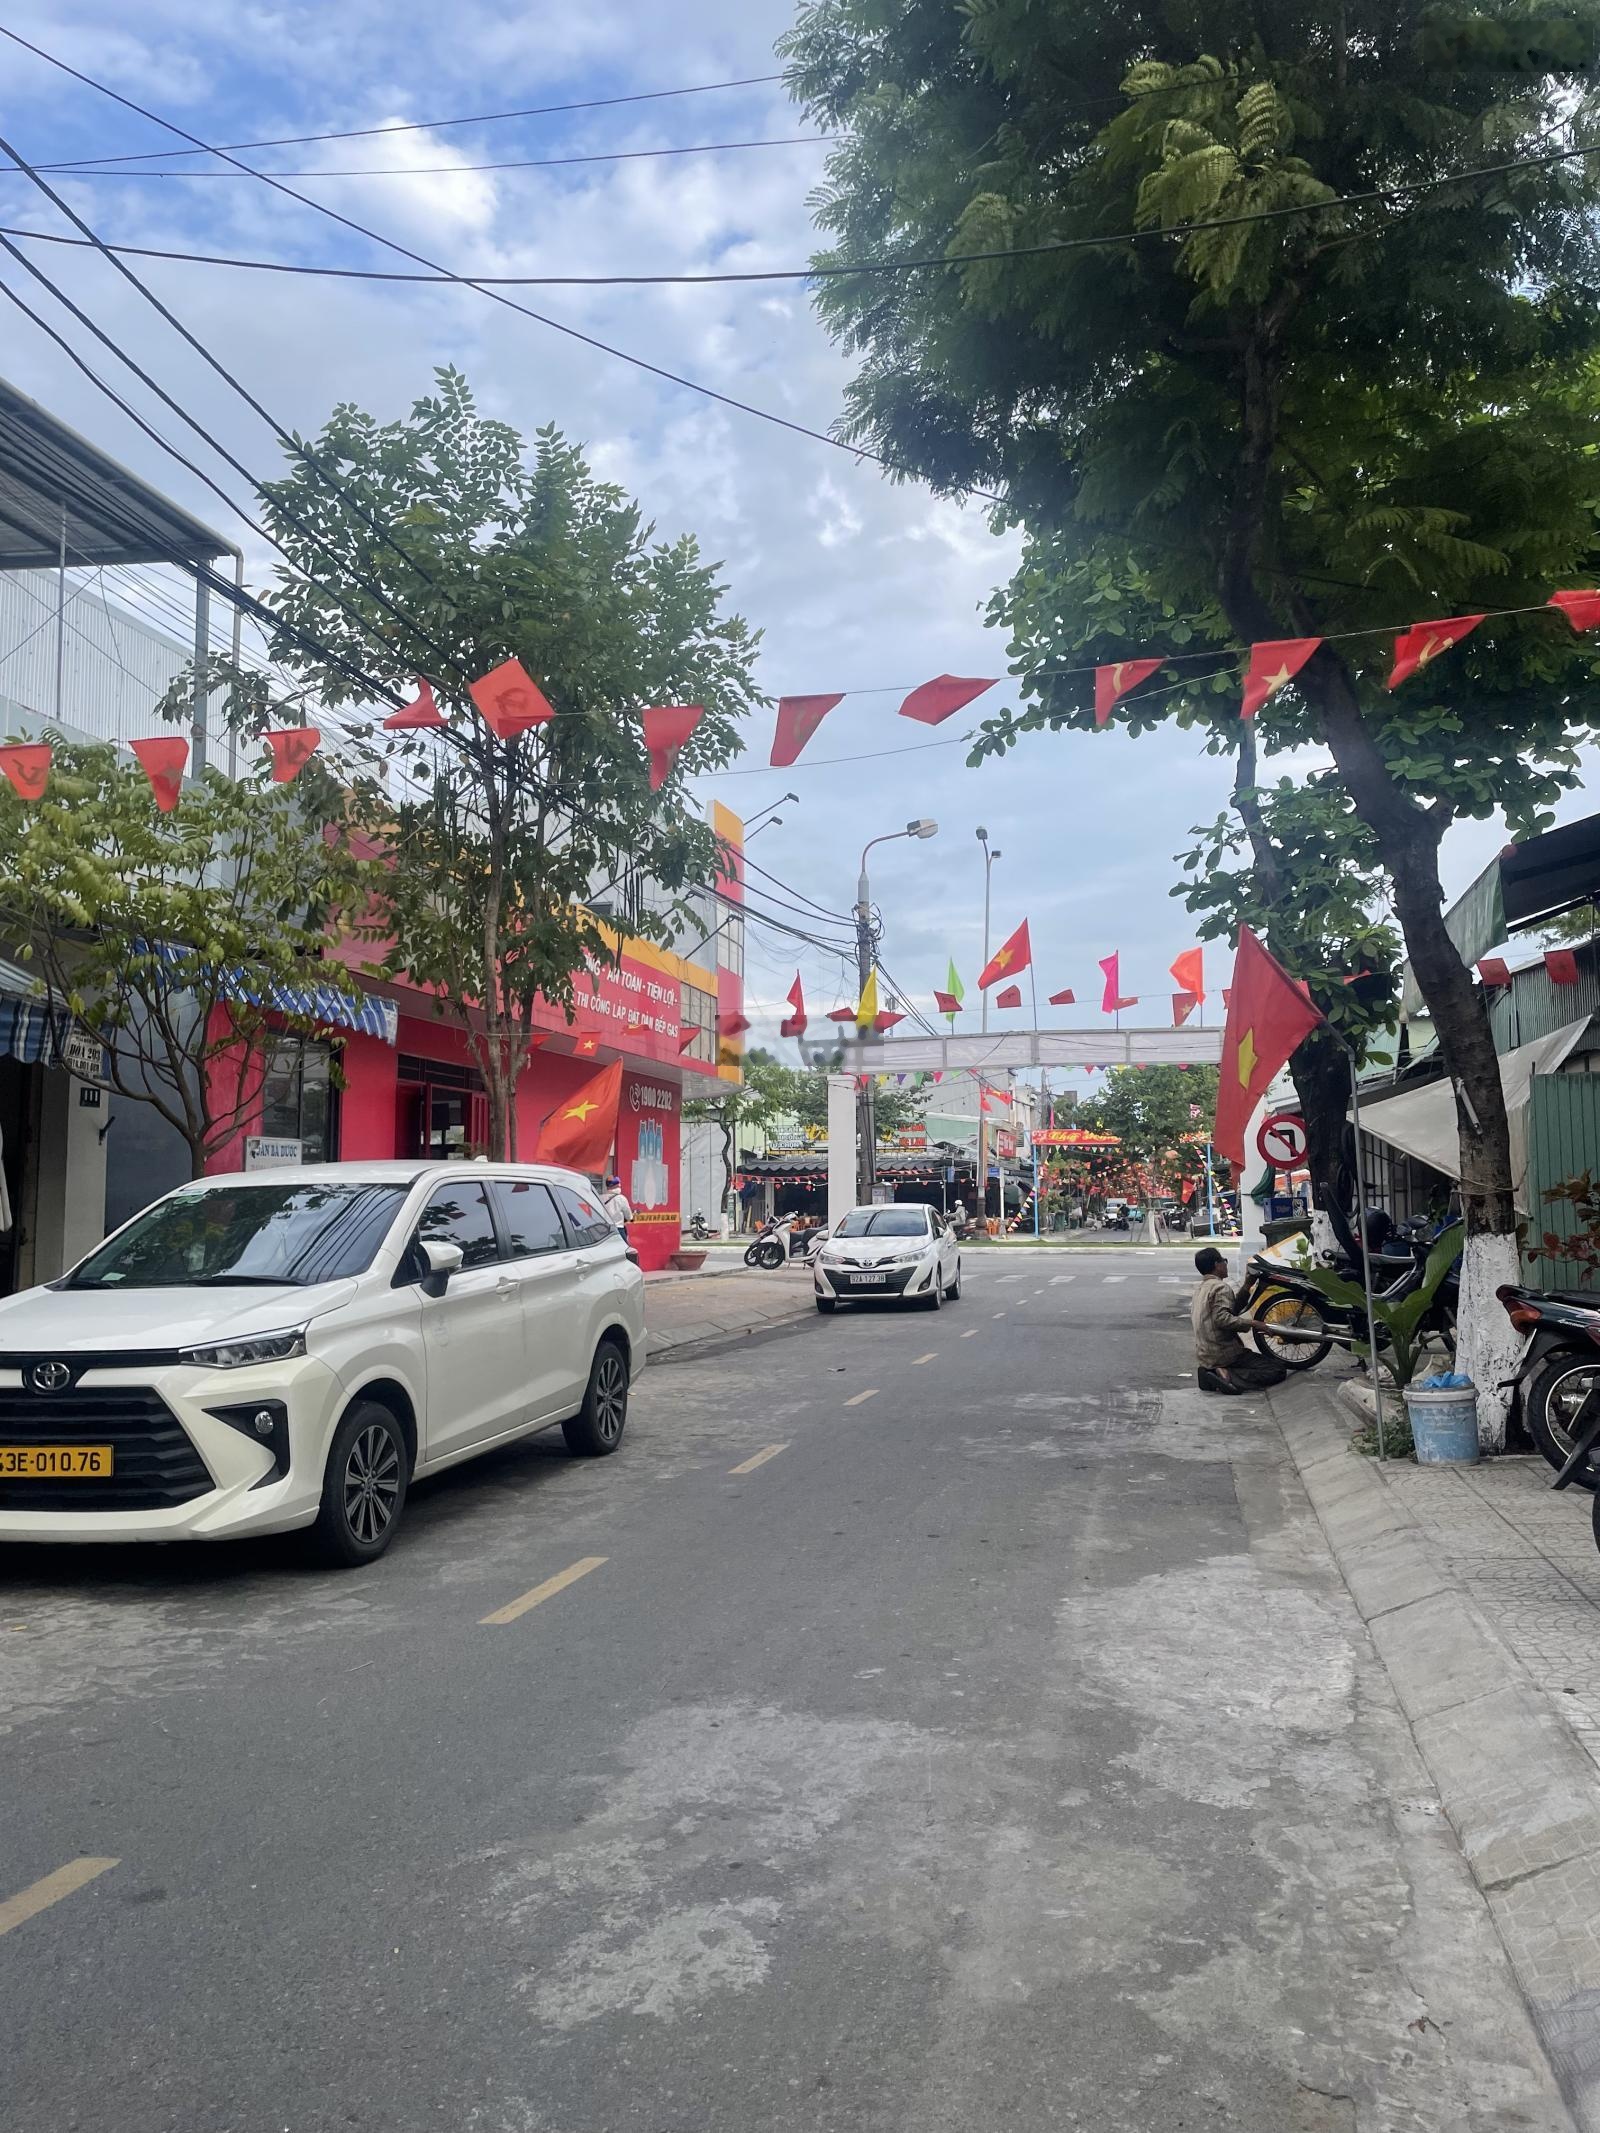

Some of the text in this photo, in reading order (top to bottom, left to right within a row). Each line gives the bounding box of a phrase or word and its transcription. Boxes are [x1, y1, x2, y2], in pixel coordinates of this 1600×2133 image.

[621, 970, 642, 992] TOÀN
[576, 991, 589, 1009] THI
[590, 994, 611, 1015] CÔNG
[666, 1023, 679, 1038] GAS
